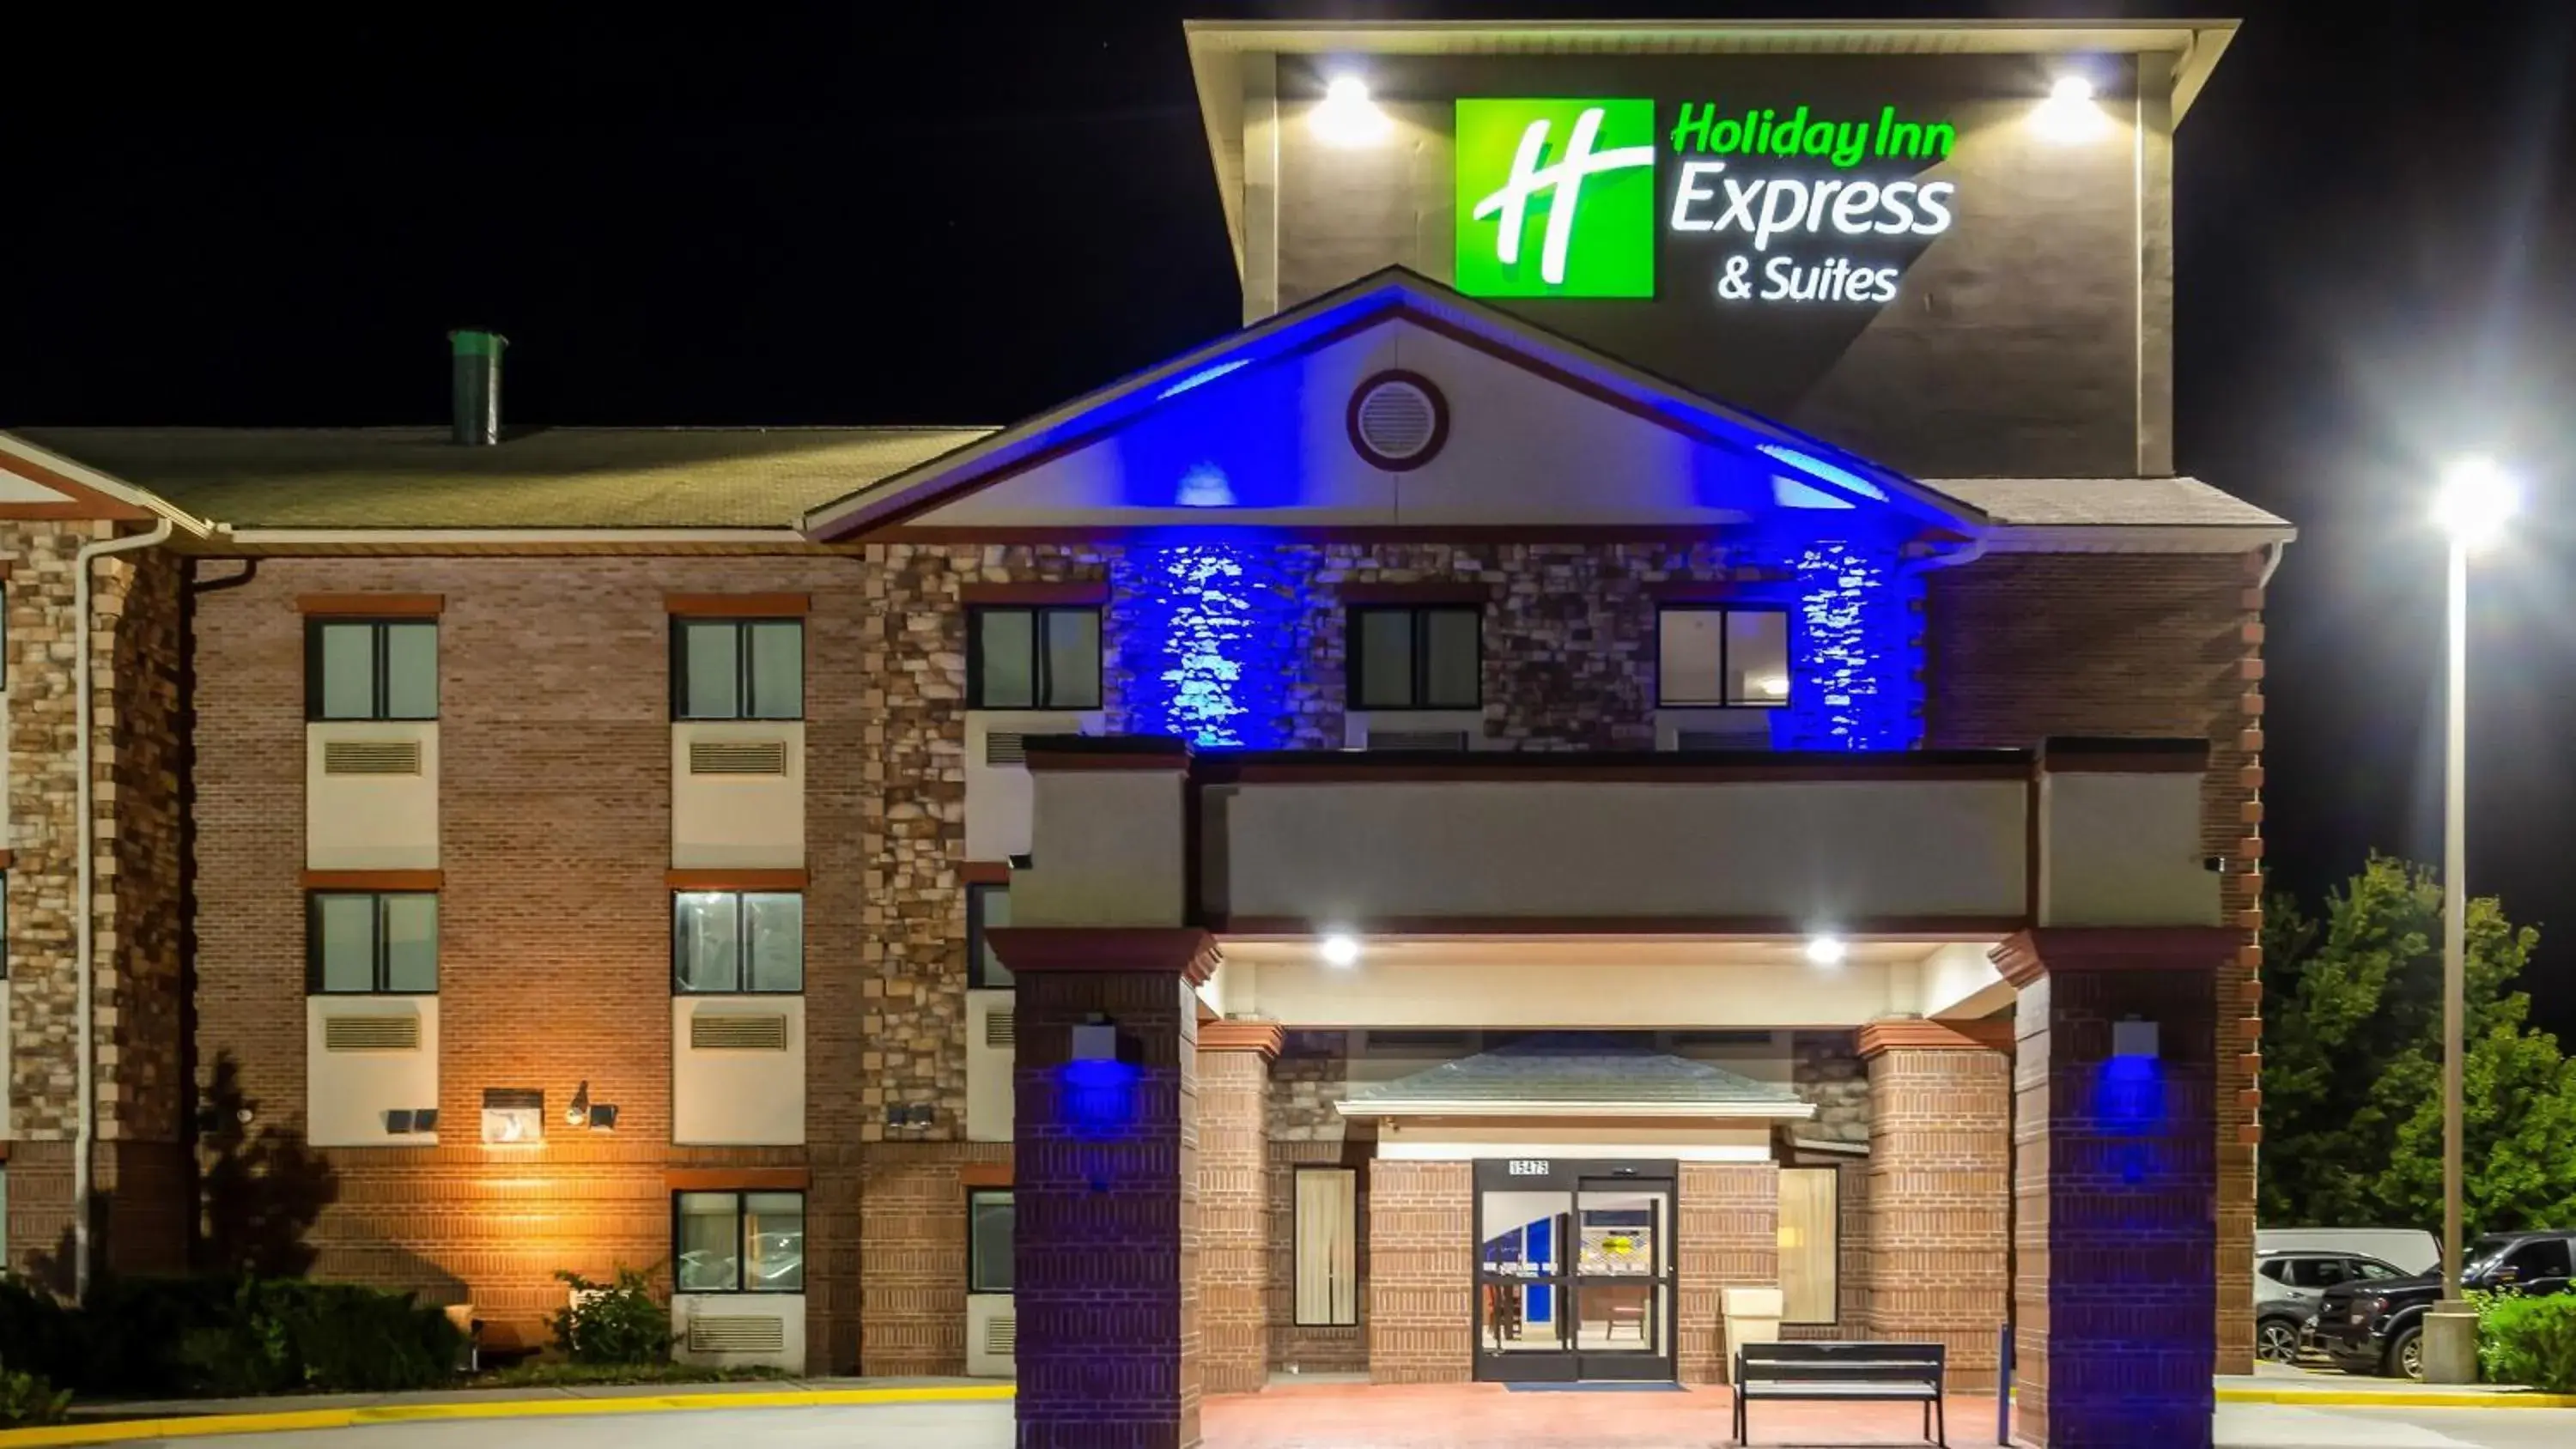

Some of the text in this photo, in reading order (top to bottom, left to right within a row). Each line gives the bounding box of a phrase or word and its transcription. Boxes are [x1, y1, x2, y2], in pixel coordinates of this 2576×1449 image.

[1671, 103, 1955, 167] Holiday Inn
[1671, 161, 1954, 251] Express
[1718, 256, 1898, 302] & Suites
